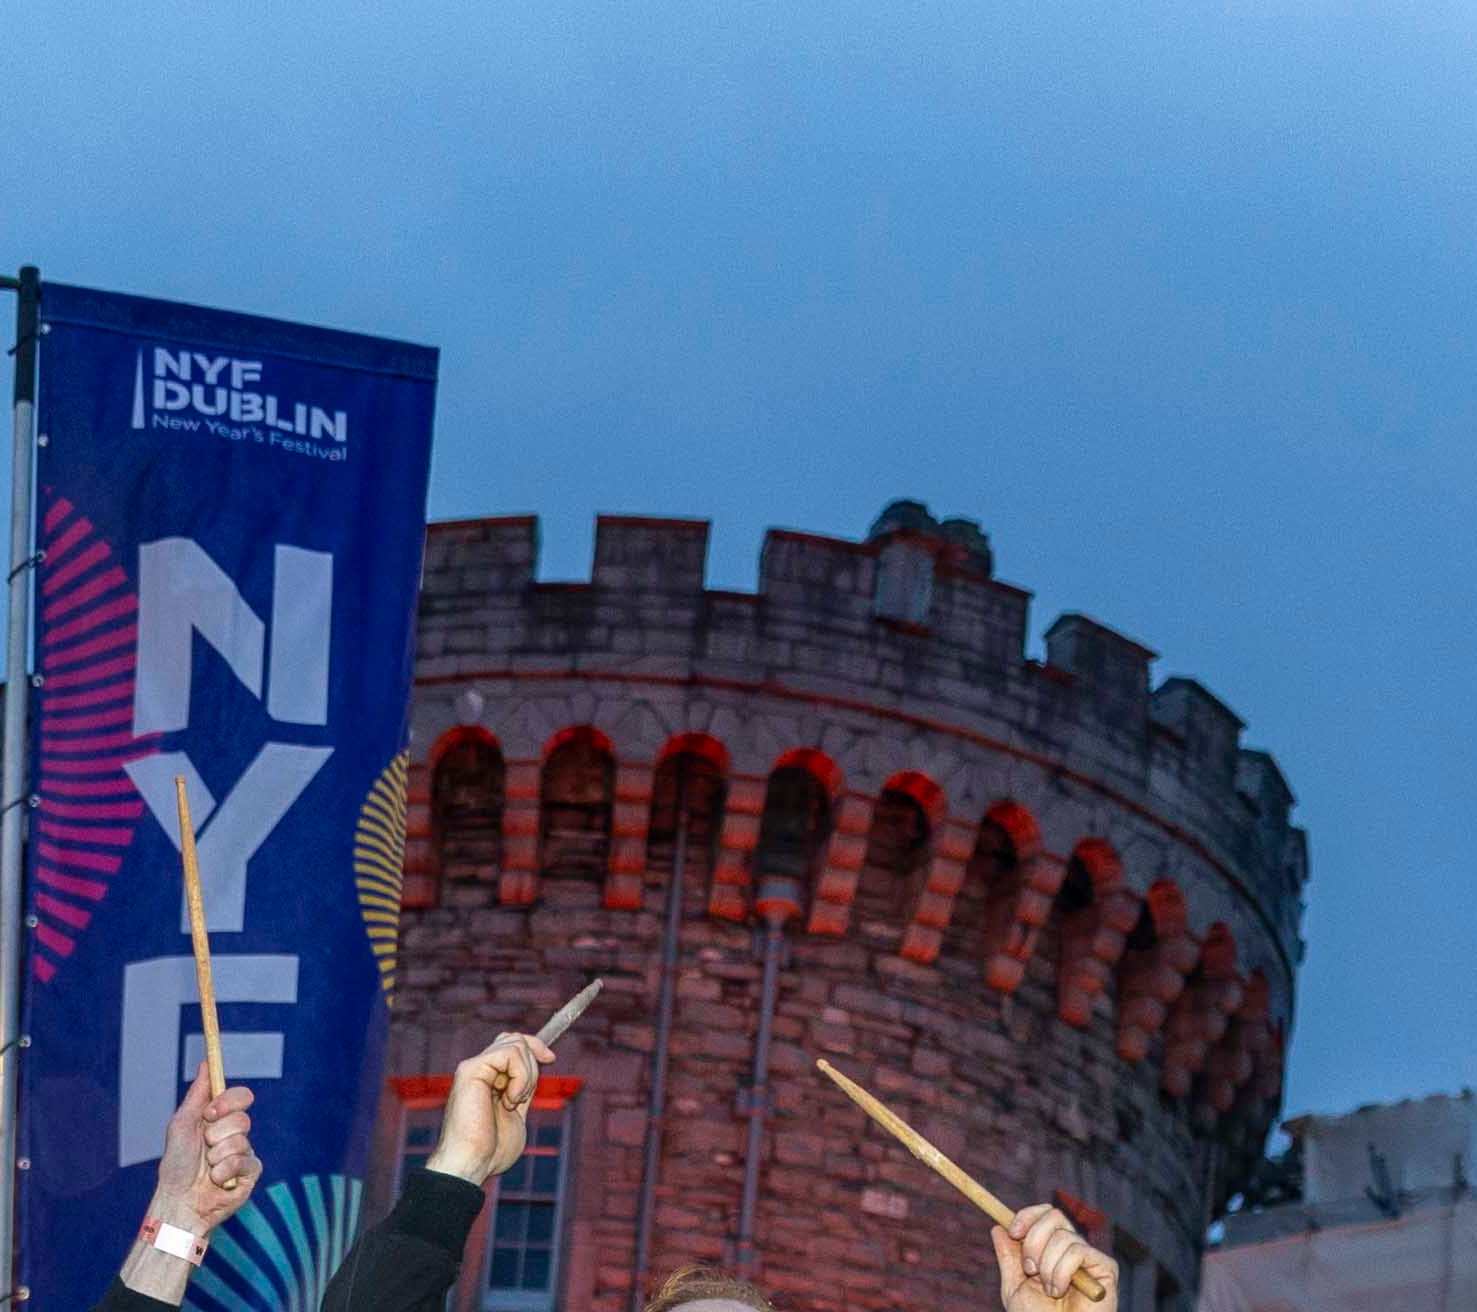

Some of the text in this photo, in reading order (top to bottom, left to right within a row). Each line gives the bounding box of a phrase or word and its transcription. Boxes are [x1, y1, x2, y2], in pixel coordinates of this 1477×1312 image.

[153, 347, 263, 389] NYF
[152, 378, 348, 443] DUBLIN
[151, 413, 347, 462] New Year's Festival
